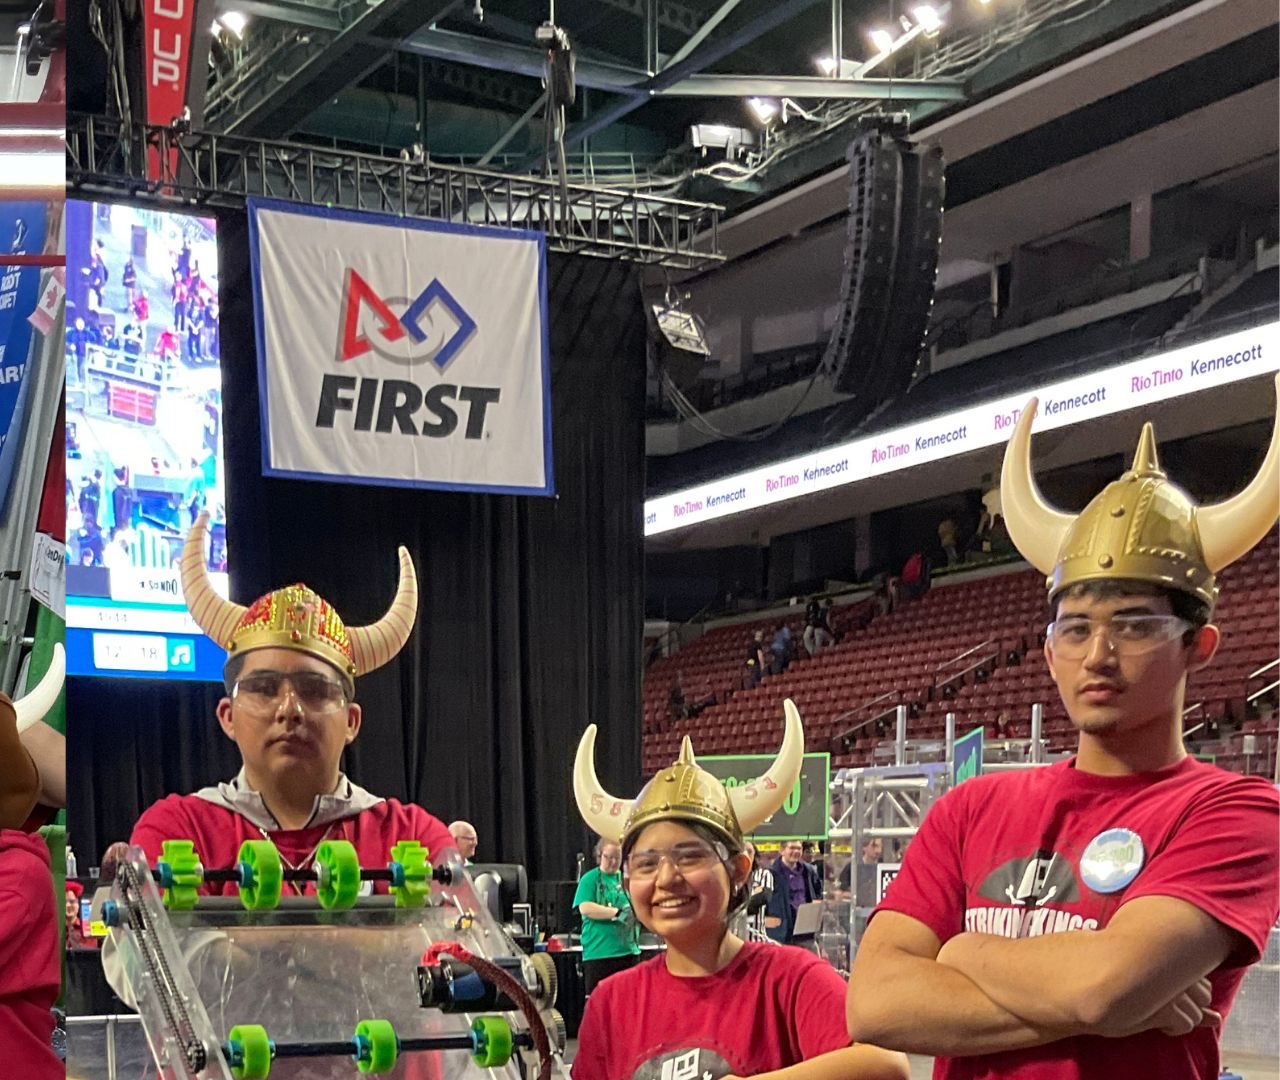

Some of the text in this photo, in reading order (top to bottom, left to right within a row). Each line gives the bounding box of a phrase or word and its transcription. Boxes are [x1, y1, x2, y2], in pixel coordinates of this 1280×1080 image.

[1190, 344, 1263, 377] Kennecott
[316, 373, 501, 440] FIRST
[1044, 386, 1107, 416] Kennecott
[914, 425, 967, 452] Kennecott
[802, 458, 849, 481] Kennecott
[705, 487, 747, 508] Kennecott
